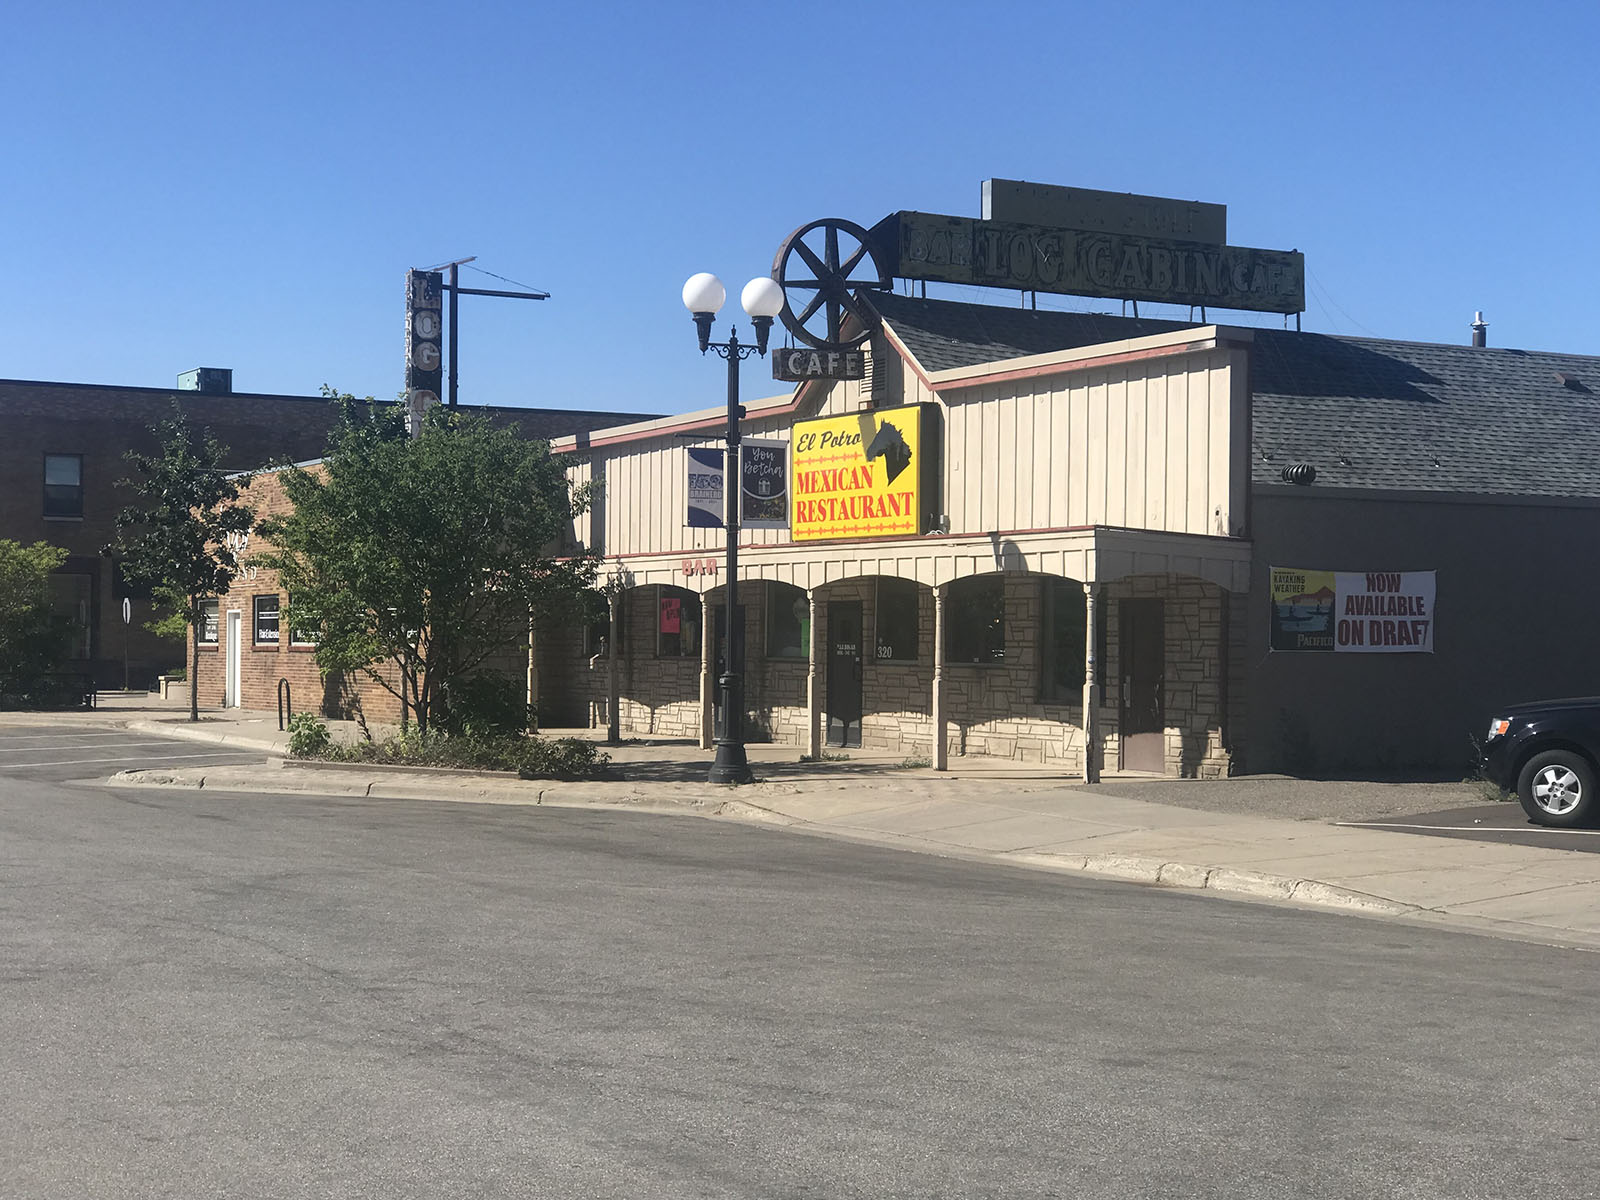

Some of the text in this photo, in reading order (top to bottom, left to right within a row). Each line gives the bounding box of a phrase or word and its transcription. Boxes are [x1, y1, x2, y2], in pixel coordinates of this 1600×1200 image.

[984, 231, 1063, 284] LOG
[1086, 238, 1219, 296] CABIN
[1231, 261, 1299, 296] CAFE
[413, 279, 441, 372] LOG
[788, 352, 858, 376] CAFE
[797, 430, 861, 453] El Potro
[752, 447, 775, 461] You
[744, 461, 784, 478] Betcha
[796, 465, 874, 495] MEXICAN
[796, 492, 914, 524] RESTAURANT
[682, 559, 717, 576] BAR
[1274, 584, 1306, 593] WEATHER
[1366, 573, 1402, 593] NOW
[1344, 595, 1426, 617] AVAILABLE
[1338, 619, 1364, 646] ON
[877, 646, 892, 658] 320
